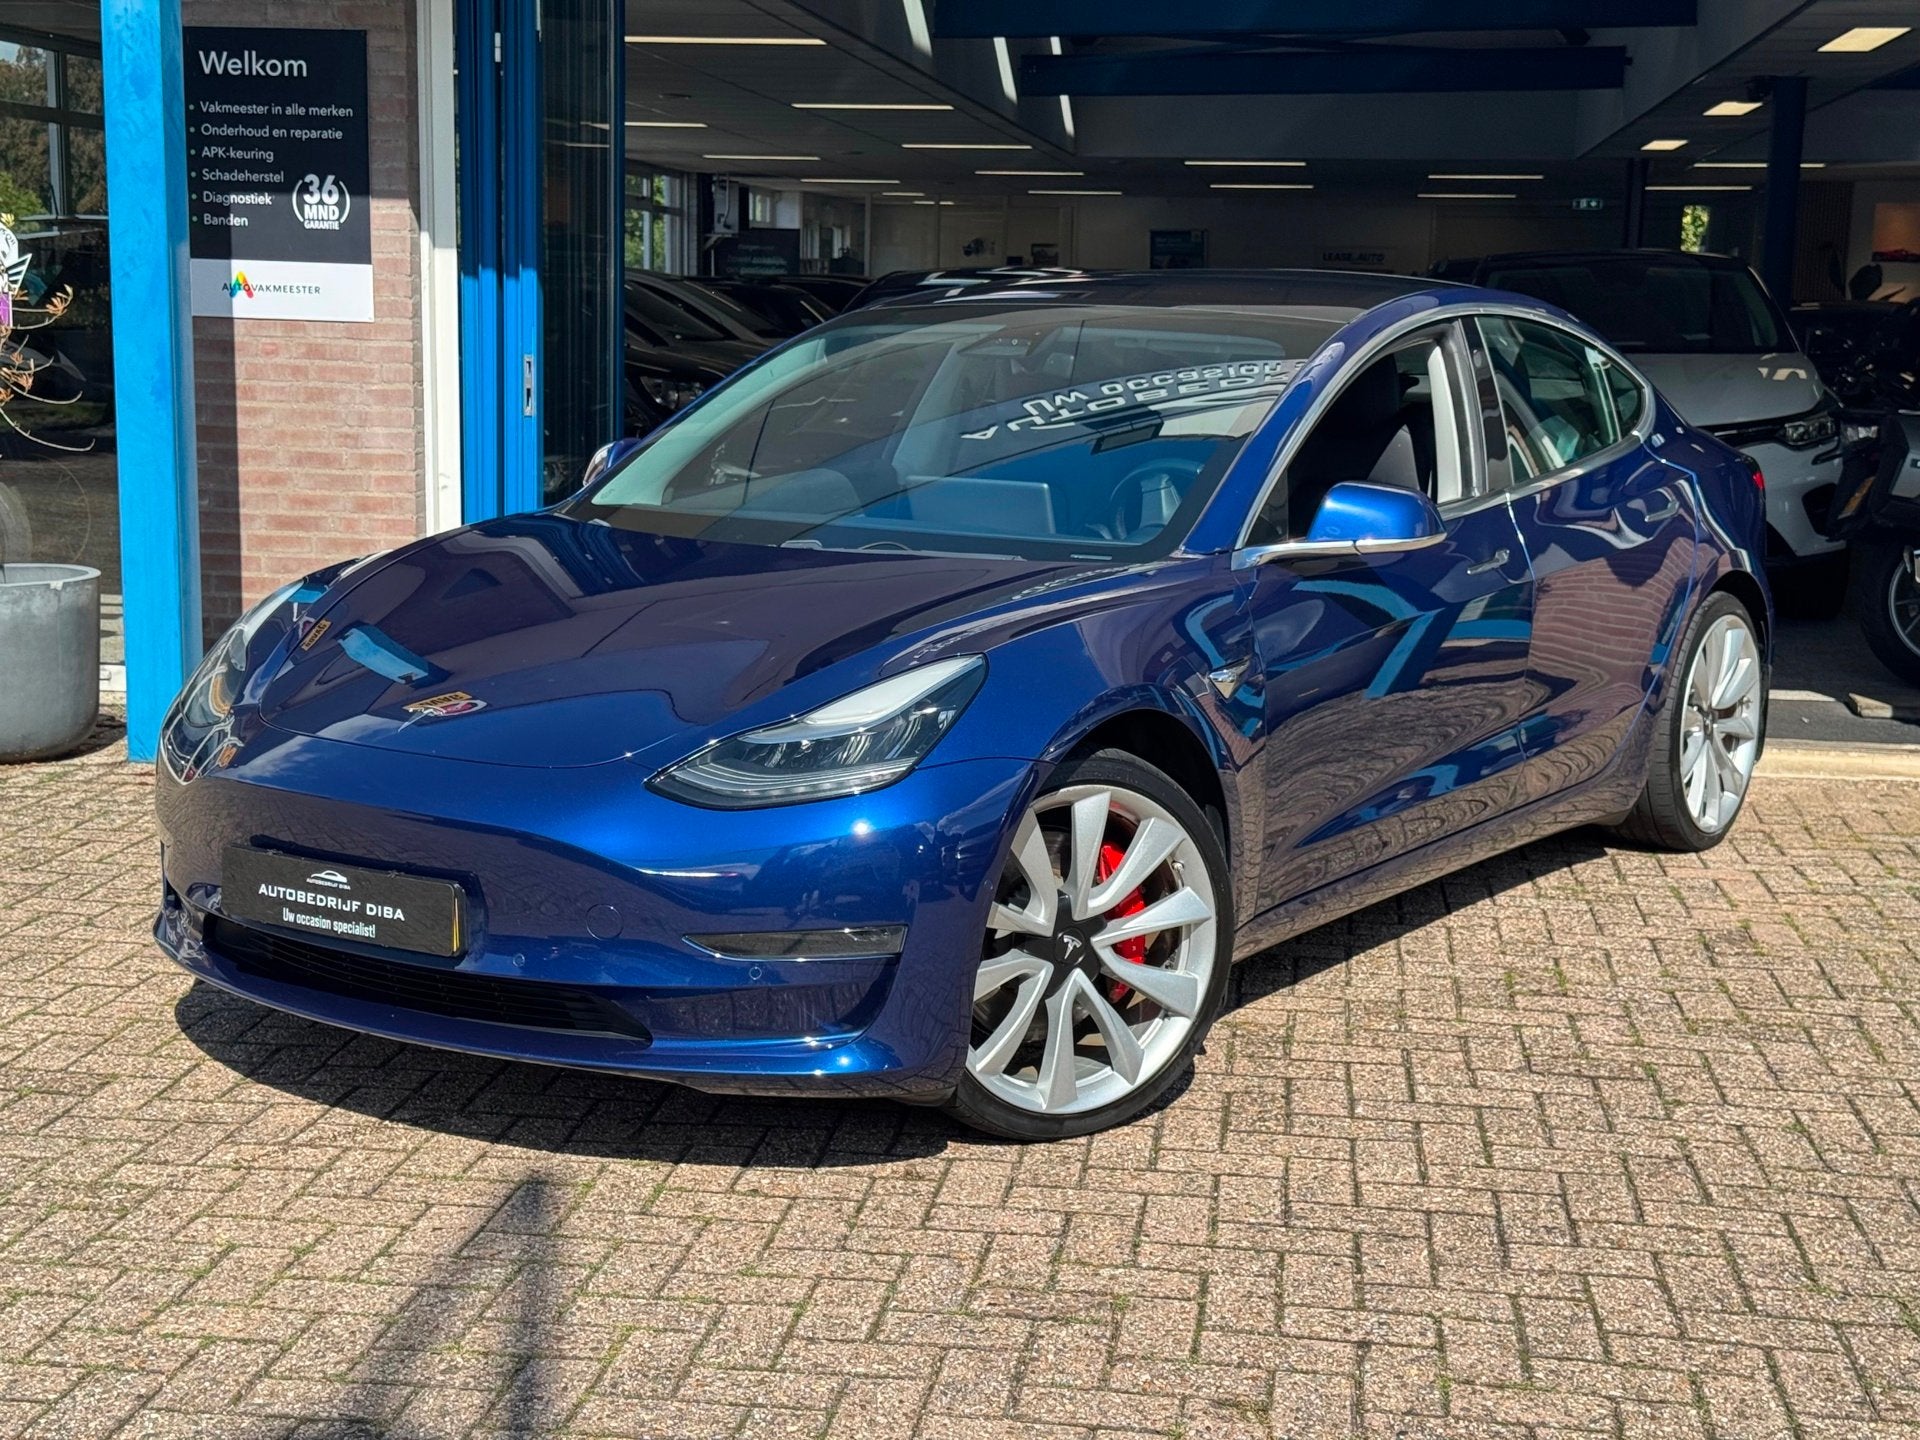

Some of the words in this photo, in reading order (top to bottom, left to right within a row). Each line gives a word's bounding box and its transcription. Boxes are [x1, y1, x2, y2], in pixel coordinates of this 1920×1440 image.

[199, 50, 308, 77] Welkom
[200, 101, 269, 114] Vakmeester
[272, 103, 282, 115] in
[285, 103, 306, 116] alle
[309, 104, 353, 117] merken
[201, 123, 269, 137] Onderhoud
[272, 128, 287, 138] en
[290, 127, 343, 141] reparatie
[202, 146, 274, 163] APK-keuring
[202, 168, 284, 183] Schadeherstel
[303, 173, 340, 205] 36
[203, 191, 272, 206] Diagnostiek
[203, 213, 248, 227] Banden
[304, 205, 340, 221] MND
[304, 220, 340, 231] GARANTIE
[258, 883, 361, 913] AUTOBEDRIJF
[366, 903, 405, 922] DIBA
[283, 907, 294, 923] Uw
[296, 913, 331, 931] occasion
[333, 920, 376, 939] specialist!
